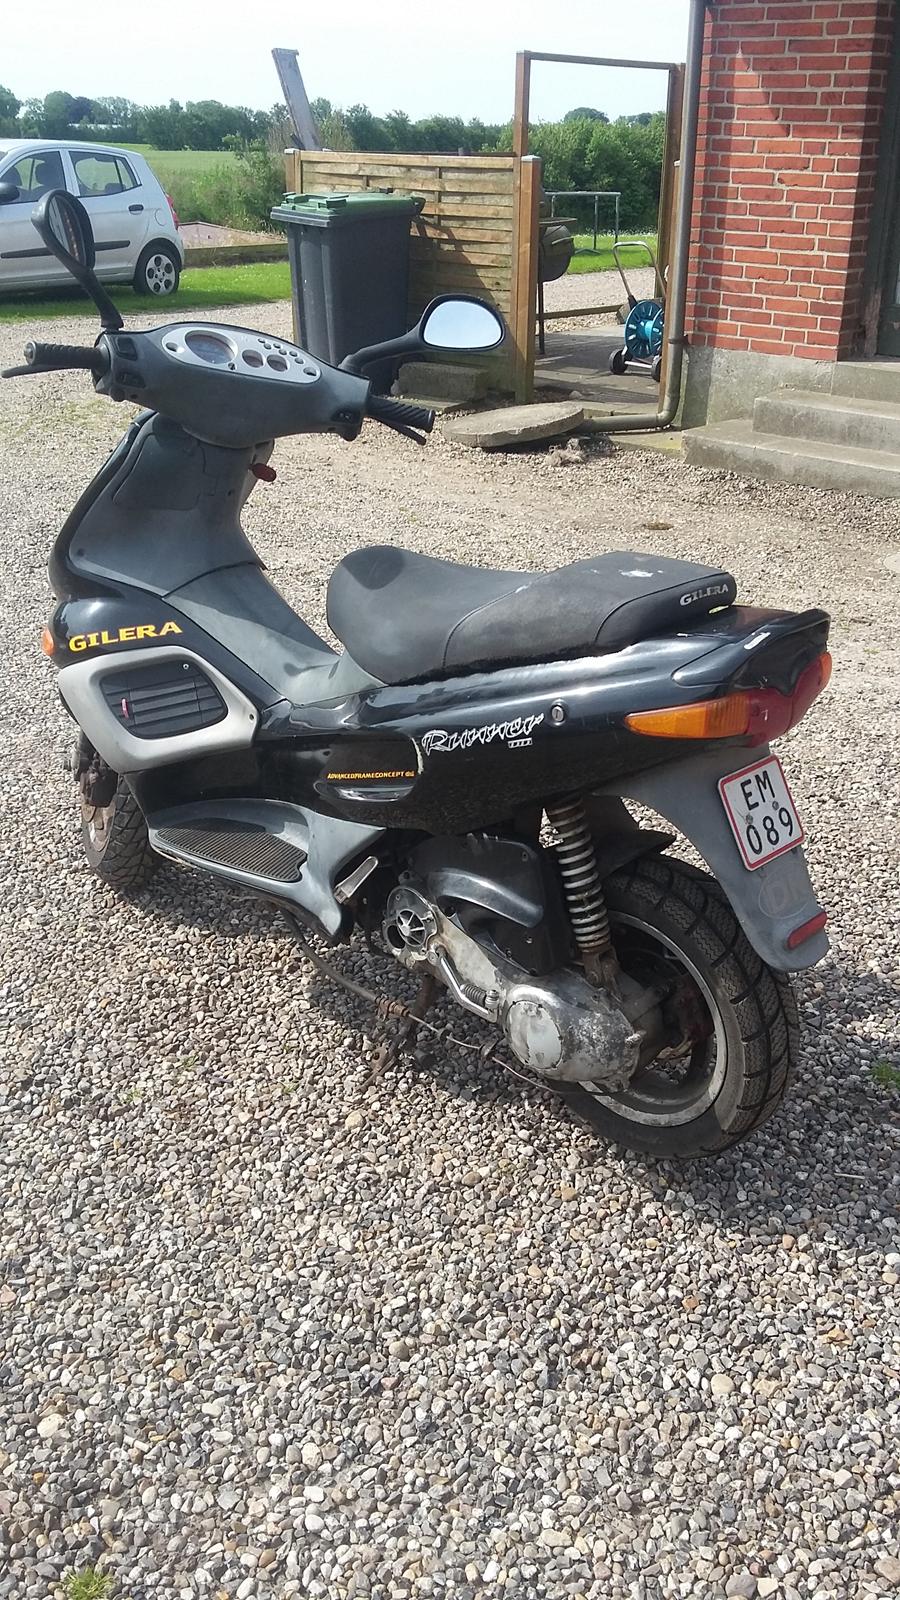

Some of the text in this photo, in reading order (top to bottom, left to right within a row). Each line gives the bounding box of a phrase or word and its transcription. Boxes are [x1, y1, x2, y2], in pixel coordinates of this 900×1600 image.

[680, 583, 729, 606] GILERA
[69, 621, 183, 652] GILERA
[421, 713, 544, 756] Runner
[740, 770, 776, 811] EM
[746, 807, 794, 855] 089
